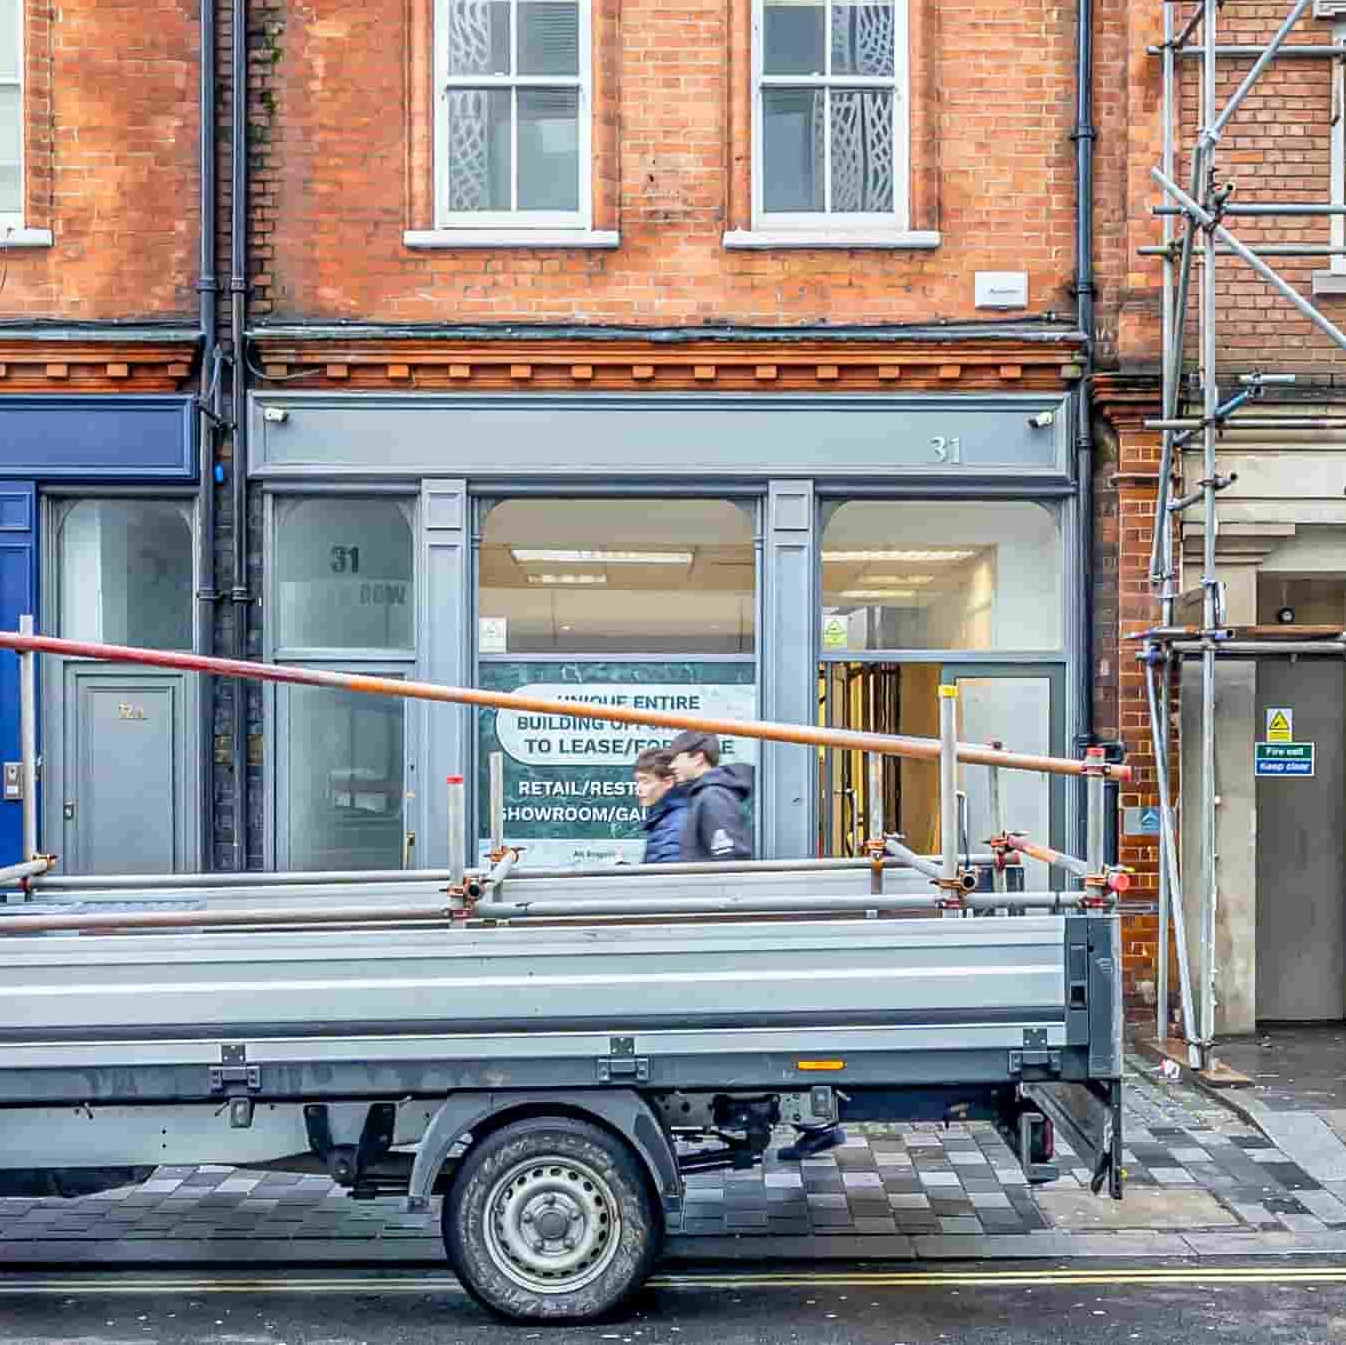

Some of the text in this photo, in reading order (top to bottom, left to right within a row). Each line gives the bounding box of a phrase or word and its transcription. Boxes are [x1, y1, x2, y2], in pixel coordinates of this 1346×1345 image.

[927, 436, 960, 463] 31
[331, 545, 359, 574] 31
[634, 695, 701, 710] ENTIRE
[517, 716, 604, 731] BUILDING
[525, 739, 551, 754] TO
[519, 781, 640, 795] RETAIL/REST
